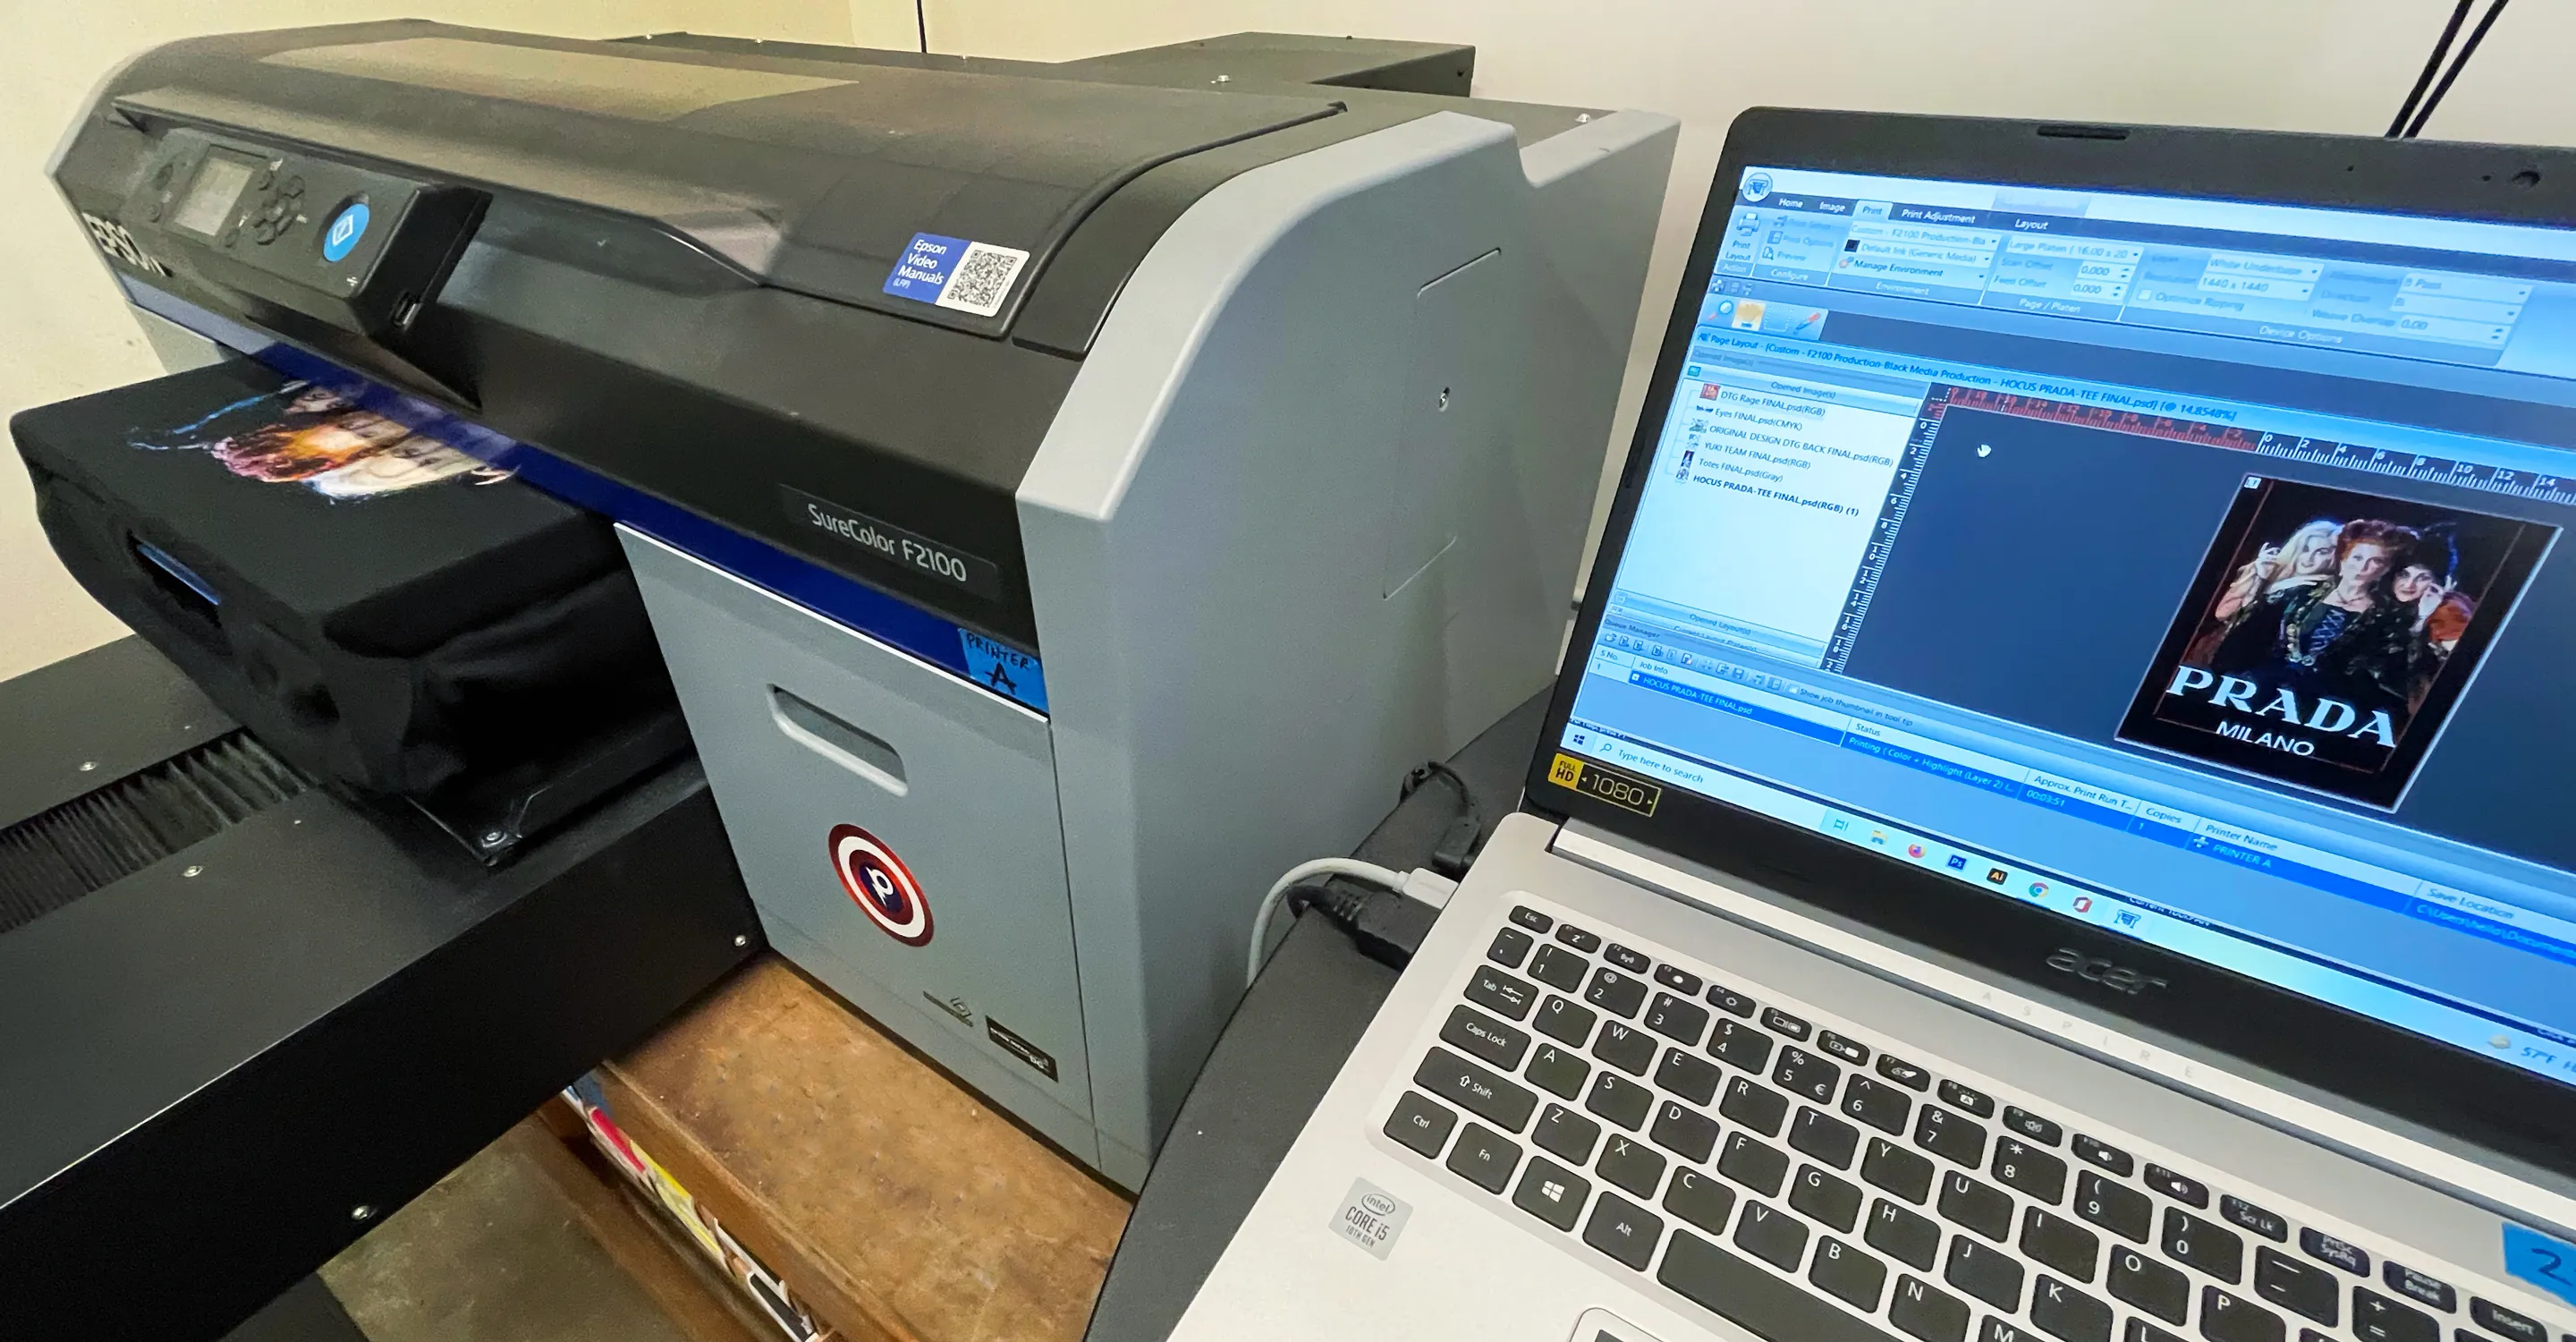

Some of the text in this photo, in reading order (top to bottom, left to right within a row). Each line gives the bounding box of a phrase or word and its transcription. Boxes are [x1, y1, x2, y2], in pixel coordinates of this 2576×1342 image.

[1779, 198, 1803, 208] Home
[1819, 201, 1845, 213] Image
[1863, 206, 1882, 215] Print
[1902, 209, 1976, 224] Print Adjustment
[2015, 219, 2048, 230] Layout
[913, 239, 947, 256] Epson
[907, 252, 937, 269] Video
[1854, 259, 1887, 272] Manage
[898, 266, 945, 285] Manuals
[1710, 335, 1730, 344] Page
[1732, 339, 1758, 349] Layout
[1808, 350, 1833, 360] F2100
[1910, 365, 1938, 377] Media
[1941, 369, 1991, 385] Production
[2001, 378, 2036, 391] HOCUS
[2039, 385, 2099, 402] PRADA-TEE
[1771, 381, 1801, 393] Opened
[1720, 391, 1826, 417] DTG Rage FINAL.psd(RGB)
[1715, 408, 1802, 431] Eyes FINAL.psd(CMYK)
[1709, 425, 1748, 438] ORIGINAL
[1750, 432, 1781, 445] DESIGN
[1783, 438, 1800, 448] DTG
[1802, 442, 1826, 454] BACK
[1705, 442, 1811, 470] YUKI TEAM FINAL.psd(RGB)
[1699, 459, 1719, 470] Totes
[2457, 463, 2473, 473] 10
[2498, 471, 2514, 480] 12
[1693, 475, 1722, 487] HOCUS
[1723, 480, 1772, 498] PRADA-TEE
[1774, 491, 1843, 513] FINAL.psd(RGB)
[808, 503, 967, 582] SureColor F2100
[966, 632, 1030, 670] PRINTER
[986, 662, 1017, 695] A
[1643, 676, 1670, 691] HOCUS
[1800, 688, 1819, 700] Show
[1821, 694, 1834, 704] job
[1835, 698, 1874, 715] thumbnail
[1885, 712, 1901, 723] tool
[2166, 664, 2398, 750] PRADA
[1856, 723, 1881, 737] Status
[2216, 720, 2315, 757] MILANO
[1849, 736, 1963, 778] Printing Color Highlight
[1559, 760, 1576, 771] FULL
[1619, 750, 1703, 783] Type here to search
[1555, 768, 1574, 782] HD
[1592, 774, 1644, 805] 1080
[2073, 786, 2097, 800] Print
[2098, 793, 2118, 806] Run
[2146, 808, 2182, 824] Copies
[2206, 824, 2277, 851] Printer Name
[2213, 845, 2271, 868] PRINTER A
[1524, 912, 1538, 923] Esc
[2046, 947, 2168, 995] acer
[1483, 979, 1496, 992] Tab
[1594, 989, 1604, 999] 2
[1551, 999, 1564, 1014] Q
[1654, 1014, 1664, 1024] 3
[1465, 1022, 1507, 1048] Caps Lock
[1612, 1024, 1630, 1041] W
[1717, 1042, 1727, 1053] 4
[1543, 1049, 1556, 1063] A
[1672, 1052, 1684, 1066] E
[1605, 1076, 1614, 1090] S
[1783, 1069, 1793, 1082] 5
[1471, 1082, 1493, 1100] Shift
[1737, 1081, 1750, 1095] R
[1668, 1106, 1682, 1120] D
[1852, 1099, 1862, 1112] 6
[1412, 1115, 1430, 1129] Ctrl
[1550, 1108, 1564, 1123] Z
[1808, 1111, 1818, 1125] T
[1928, 1130, 1937, 1142] 7
[1614, 1140, 1630, 1156] X
[1735, 1137, 1748, 1151] F
[1881, 1142, 1892, 1157] Y
[1479, 1149, 1491, 1161] Fn
[2004, 1165, 2016, 1178] 8
[1682, 1174, 1696, 1188] C
[1808, 1172, 1821, 1187] G
[1955, 1180, 1970, 1193] U
[1366, 1194, 1391, 1212] intel
[2089, 1201, 2100, 1215] 9
[1756, 1207, 1768, 1222] V
[1882, 1204, 1896, 1222] H
[1345, 1206, 1390, 1241] CORE i5
[1616, 1222, 1632, 1236] Alt
[1828, 1244, 1842, 1260] B
[1962, 1244, 1971, 1258] J
[2125, 1254, 2141, 1271] O
[2530, 1248, 2573, 1287] 2
[1907, 1281, 1924, 1301] N
[2049, 1284, 2063, 1303] K
[2217, 1295, 2231, 1310] P
[1995, 1324, 2014, 1342] M
